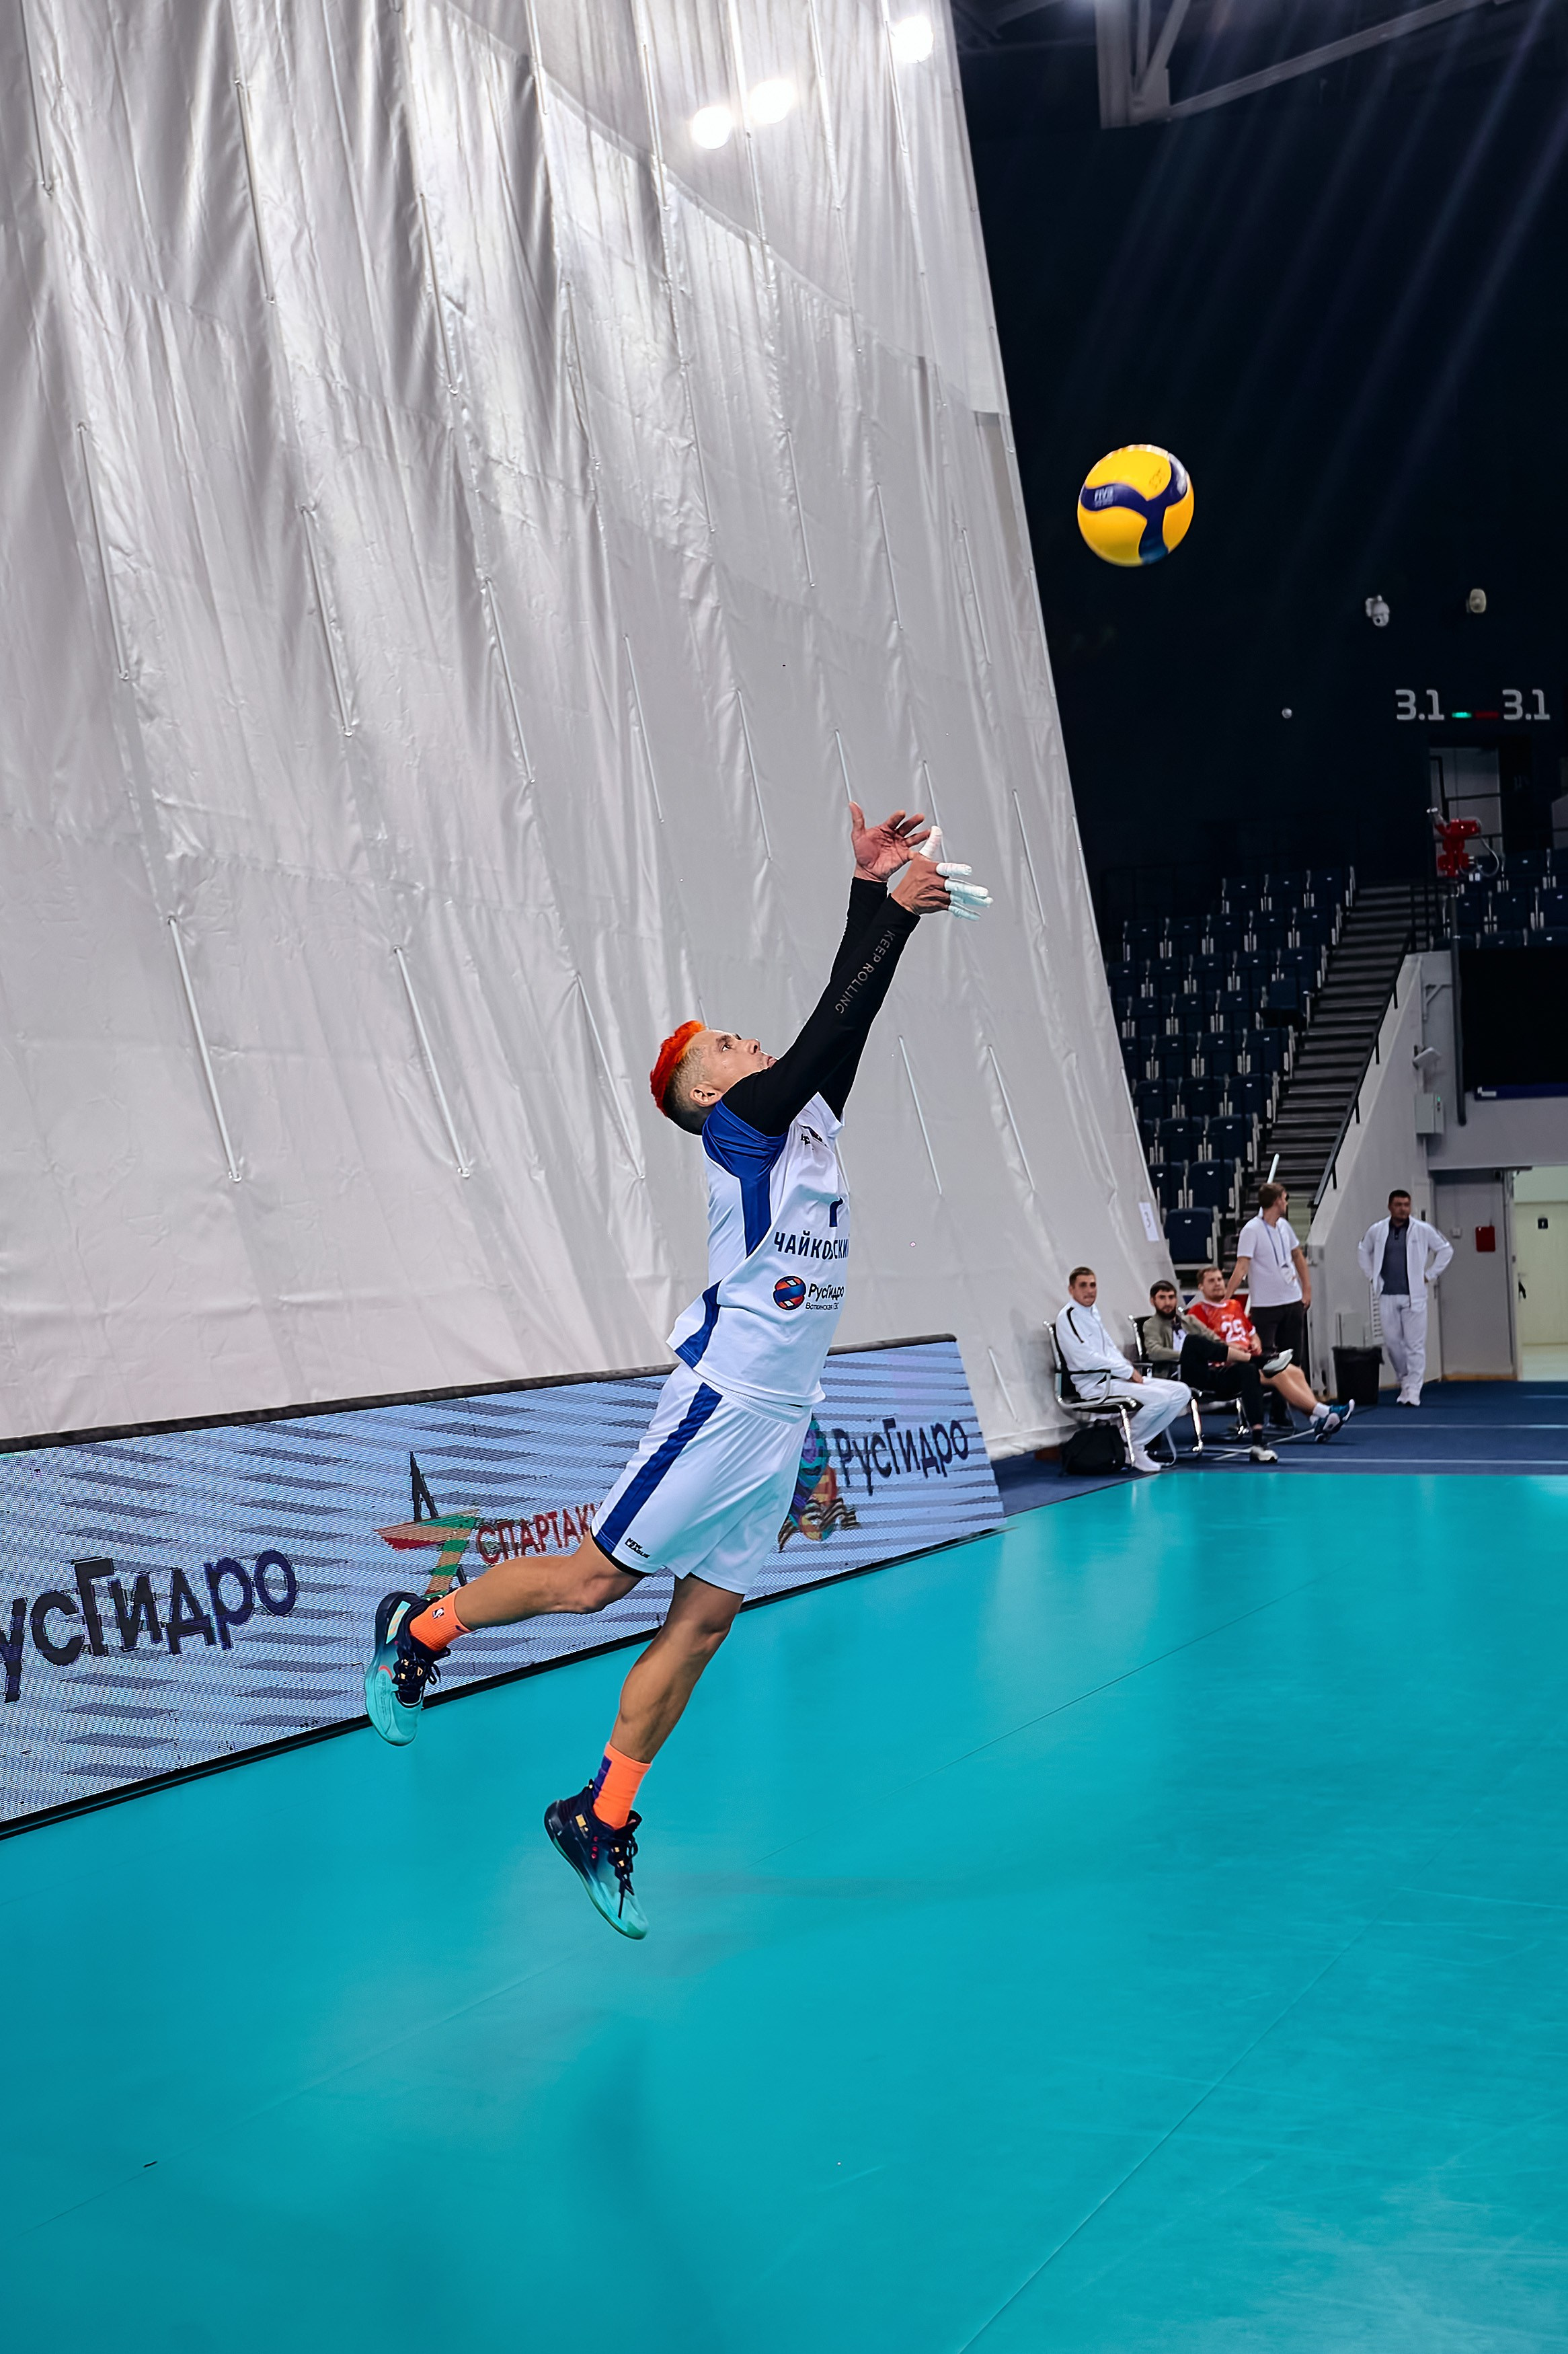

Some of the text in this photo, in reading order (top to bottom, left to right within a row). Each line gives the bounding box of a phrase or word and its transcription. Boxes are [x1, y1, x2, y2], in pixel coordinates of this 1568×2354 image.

[1395, 689, 1551, 720] 3.1 3.1
[835, 929, 896, 1014] KEEP ROLLING
[774, 1230, 849, 1260] ЧАЙКОСКИ
[832, 1416, 968, 1496] РусГидро
